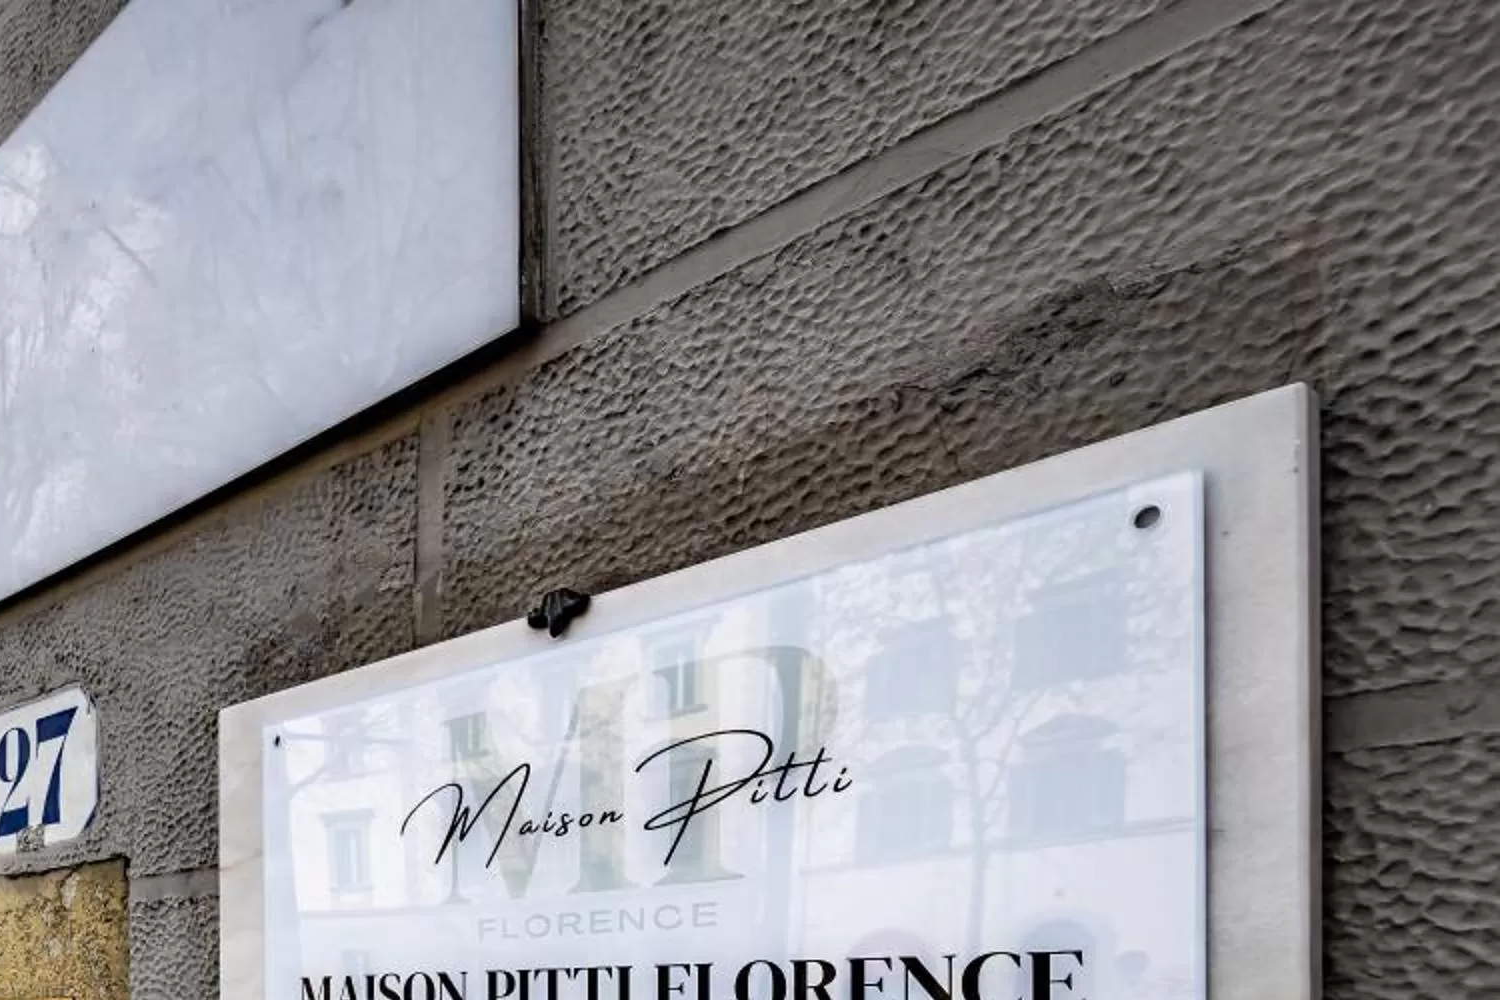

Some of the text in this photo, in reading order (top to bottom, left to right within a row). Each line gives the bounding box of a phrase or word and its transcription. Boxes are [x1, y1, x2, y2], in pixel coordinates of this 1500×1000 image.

[402, 730, 853, 869] Maison Pitti
[477, 902, 719, 941] FLORENCE
